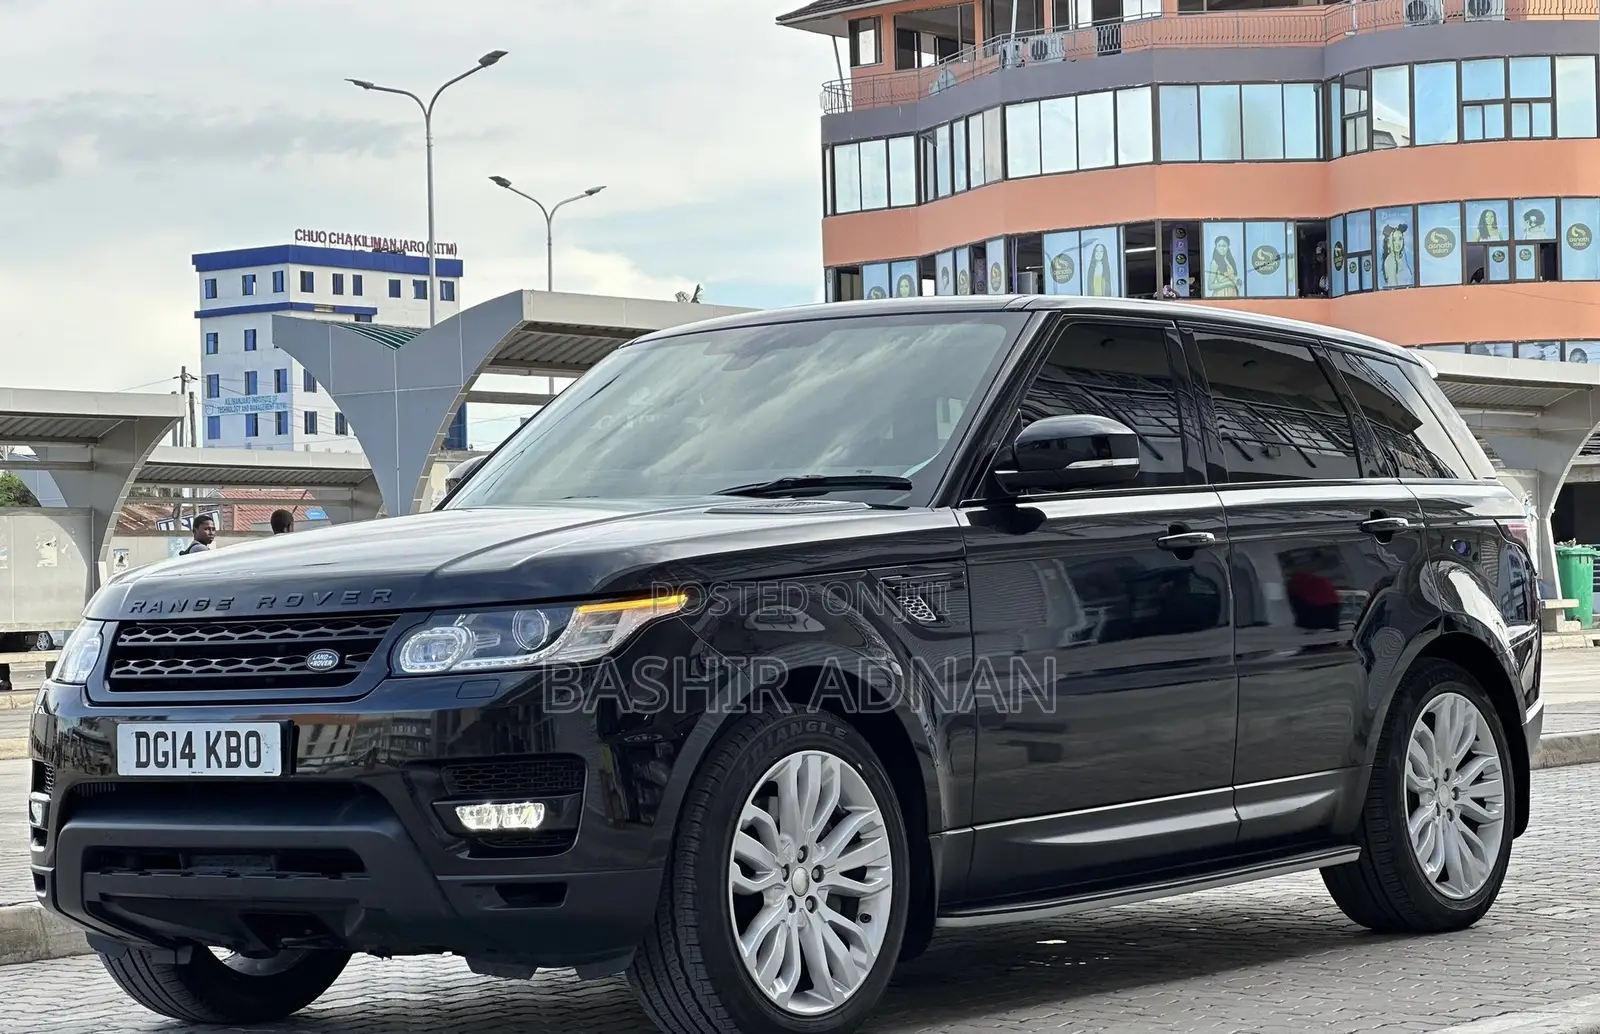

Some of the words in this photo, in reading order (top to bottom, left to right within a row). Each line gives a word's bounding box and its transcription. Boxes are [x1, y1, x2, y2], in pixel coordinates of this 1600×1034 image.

[295, 228, 327, 244] CHUO
[329, 232, 352, 246] CHA
[354, 234, 425, 253] KILIMANJARO
[129, 596, 235, 614] RANGE
[256, 587, 393, 609] ROVER
[135, 730, 196, 769] DG14
[205, 730, 262, 769] KBO
